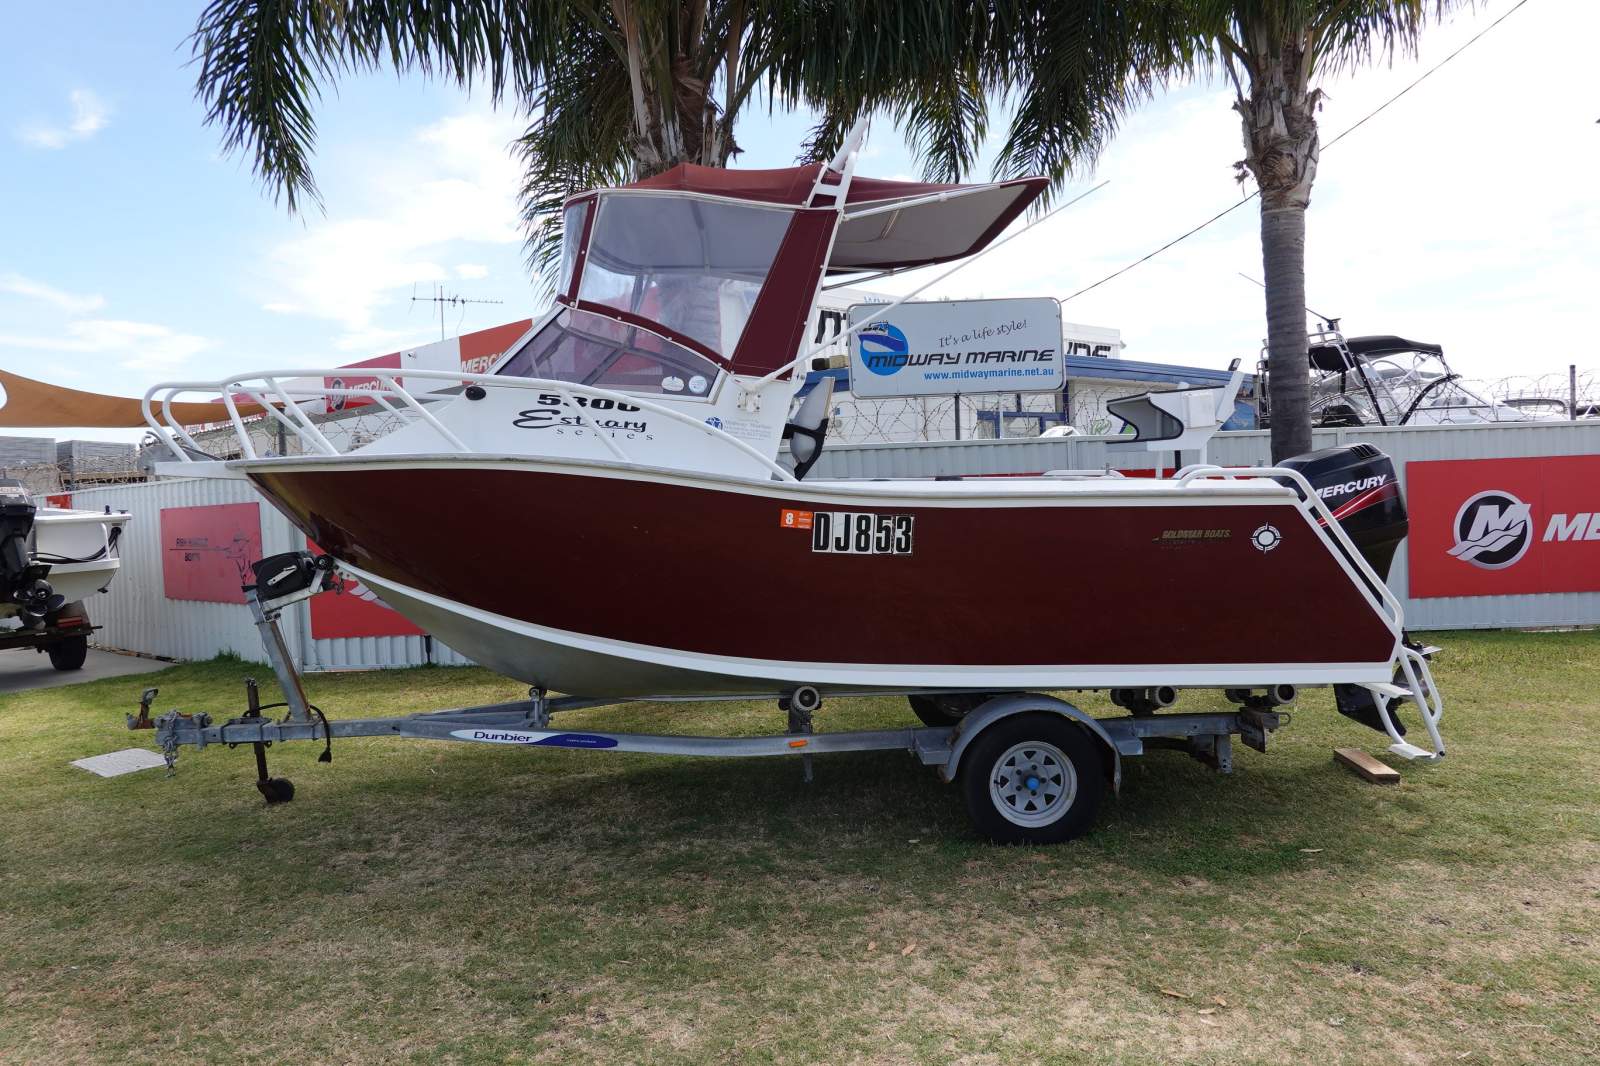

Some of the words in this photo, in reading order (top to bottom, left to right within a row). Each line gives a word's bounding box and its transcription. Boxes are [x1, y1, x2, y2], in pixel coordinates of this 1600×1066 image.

[939, 335, 960, 347] It's
[973, 326, 994, 339] life
[996, 320, 1028, 335] style!
[867, 352, 961, 368] MIDWAY
[965, 350, 1055, 364] MARINE
[924, 367, 1055, 380] www.midwaymarine.net.au
[785, 512, 794, 525] 8
[813, 512, 913, 553] DJ853
[473, 731, 533, 742] Dunbier
